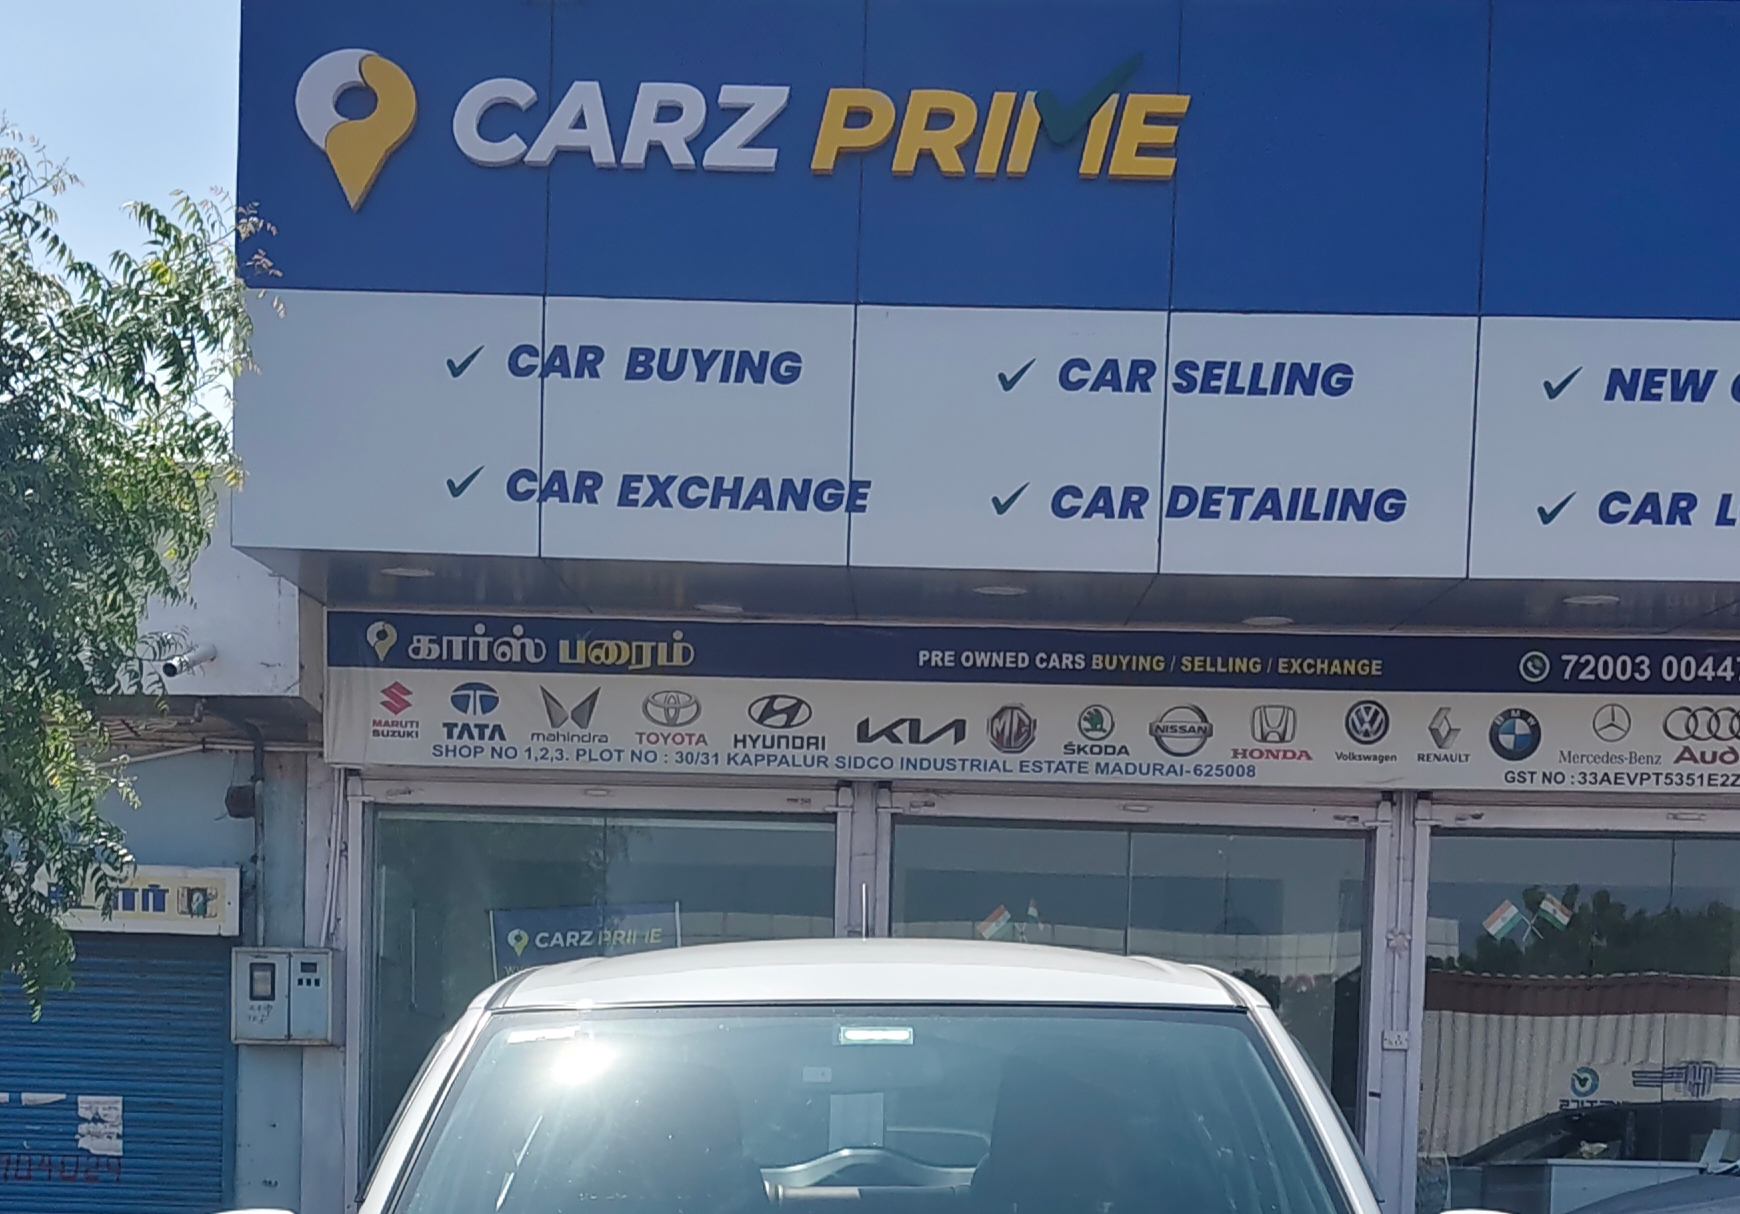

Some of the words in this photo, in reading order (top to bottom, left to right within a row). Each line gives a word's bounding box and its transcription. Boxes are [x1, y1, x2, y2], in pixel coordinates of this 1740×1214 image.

[452, 77, 791, 172] CARZ
[811, 86, 1192, 181] PRIME
[508, 344, 605, 379] CAR
[625, 347, 803, 385] BUYING
[1058, 358, 1156, 393] CAR
[1171, 360, 1355, 397] SELLING
[1603, 368, 1718, 403] NEW
[507, 468, 604, 504] CAR
[617, 474, 872, 514] EXCHANGE
[1050, 485, 1149, 520] CAR
[1165, 486, 1408, 523] DETAILING
[1599, 491, 1697, 526] CAR
[408, 623, 547, 663] கார்ஸ்
[918, 650, 955, 667] PRE
[960, 651, 1030, 668] OWNED
[1035, 652, 1085, 669] CARS
[1091, 654, 1165, 671] BUYING
[1181, 656, 1262, 673] SELLING
[1278, 658, 1383, 675] EXCHANGE
[1560, 654, 1651, 681] 72003
[1661, 656, 1740, 682] 0044
[372, 719, 419, 729] MARUTI
[442, 722, 507, 742] TATA
[1154, 724, 1208, 735] NISSAN
[372, 729, 419, 739] SUZUKI
[531, 732, 608, 743] mahindra
[635, 732, 708, 746] TOYOTA
[733, 734, 826, 750] HYUNDAI
[432, 745, 485, 759] SHOP
[490, 747, 518, 759] NO
[576, 748, 625, 762] PLOT
[630, 750, 657, 763] NO
[675, 751, 719, 765] 30/31
[727, 752, 829, 768] KAPPALUR
[835, 755, 894, 769] SIDCO
[900, 756, 1014, 772] INDUSTRIAL
[1019, 759, 1089, 774] ESTATE
[1095, 761, 1256, 777] MADURAI-625008
[1231, 748, 1313, 760] HONDA
[1335, 751, 1397, 764] Volkswagen
[1417, 753, 1471, 763] RENAULT
[1559, 750, 1662, 765] Mercedes-Benz
[1504, 770, 1537, 784] GST
[535, 930, 593, 948] CARZ
